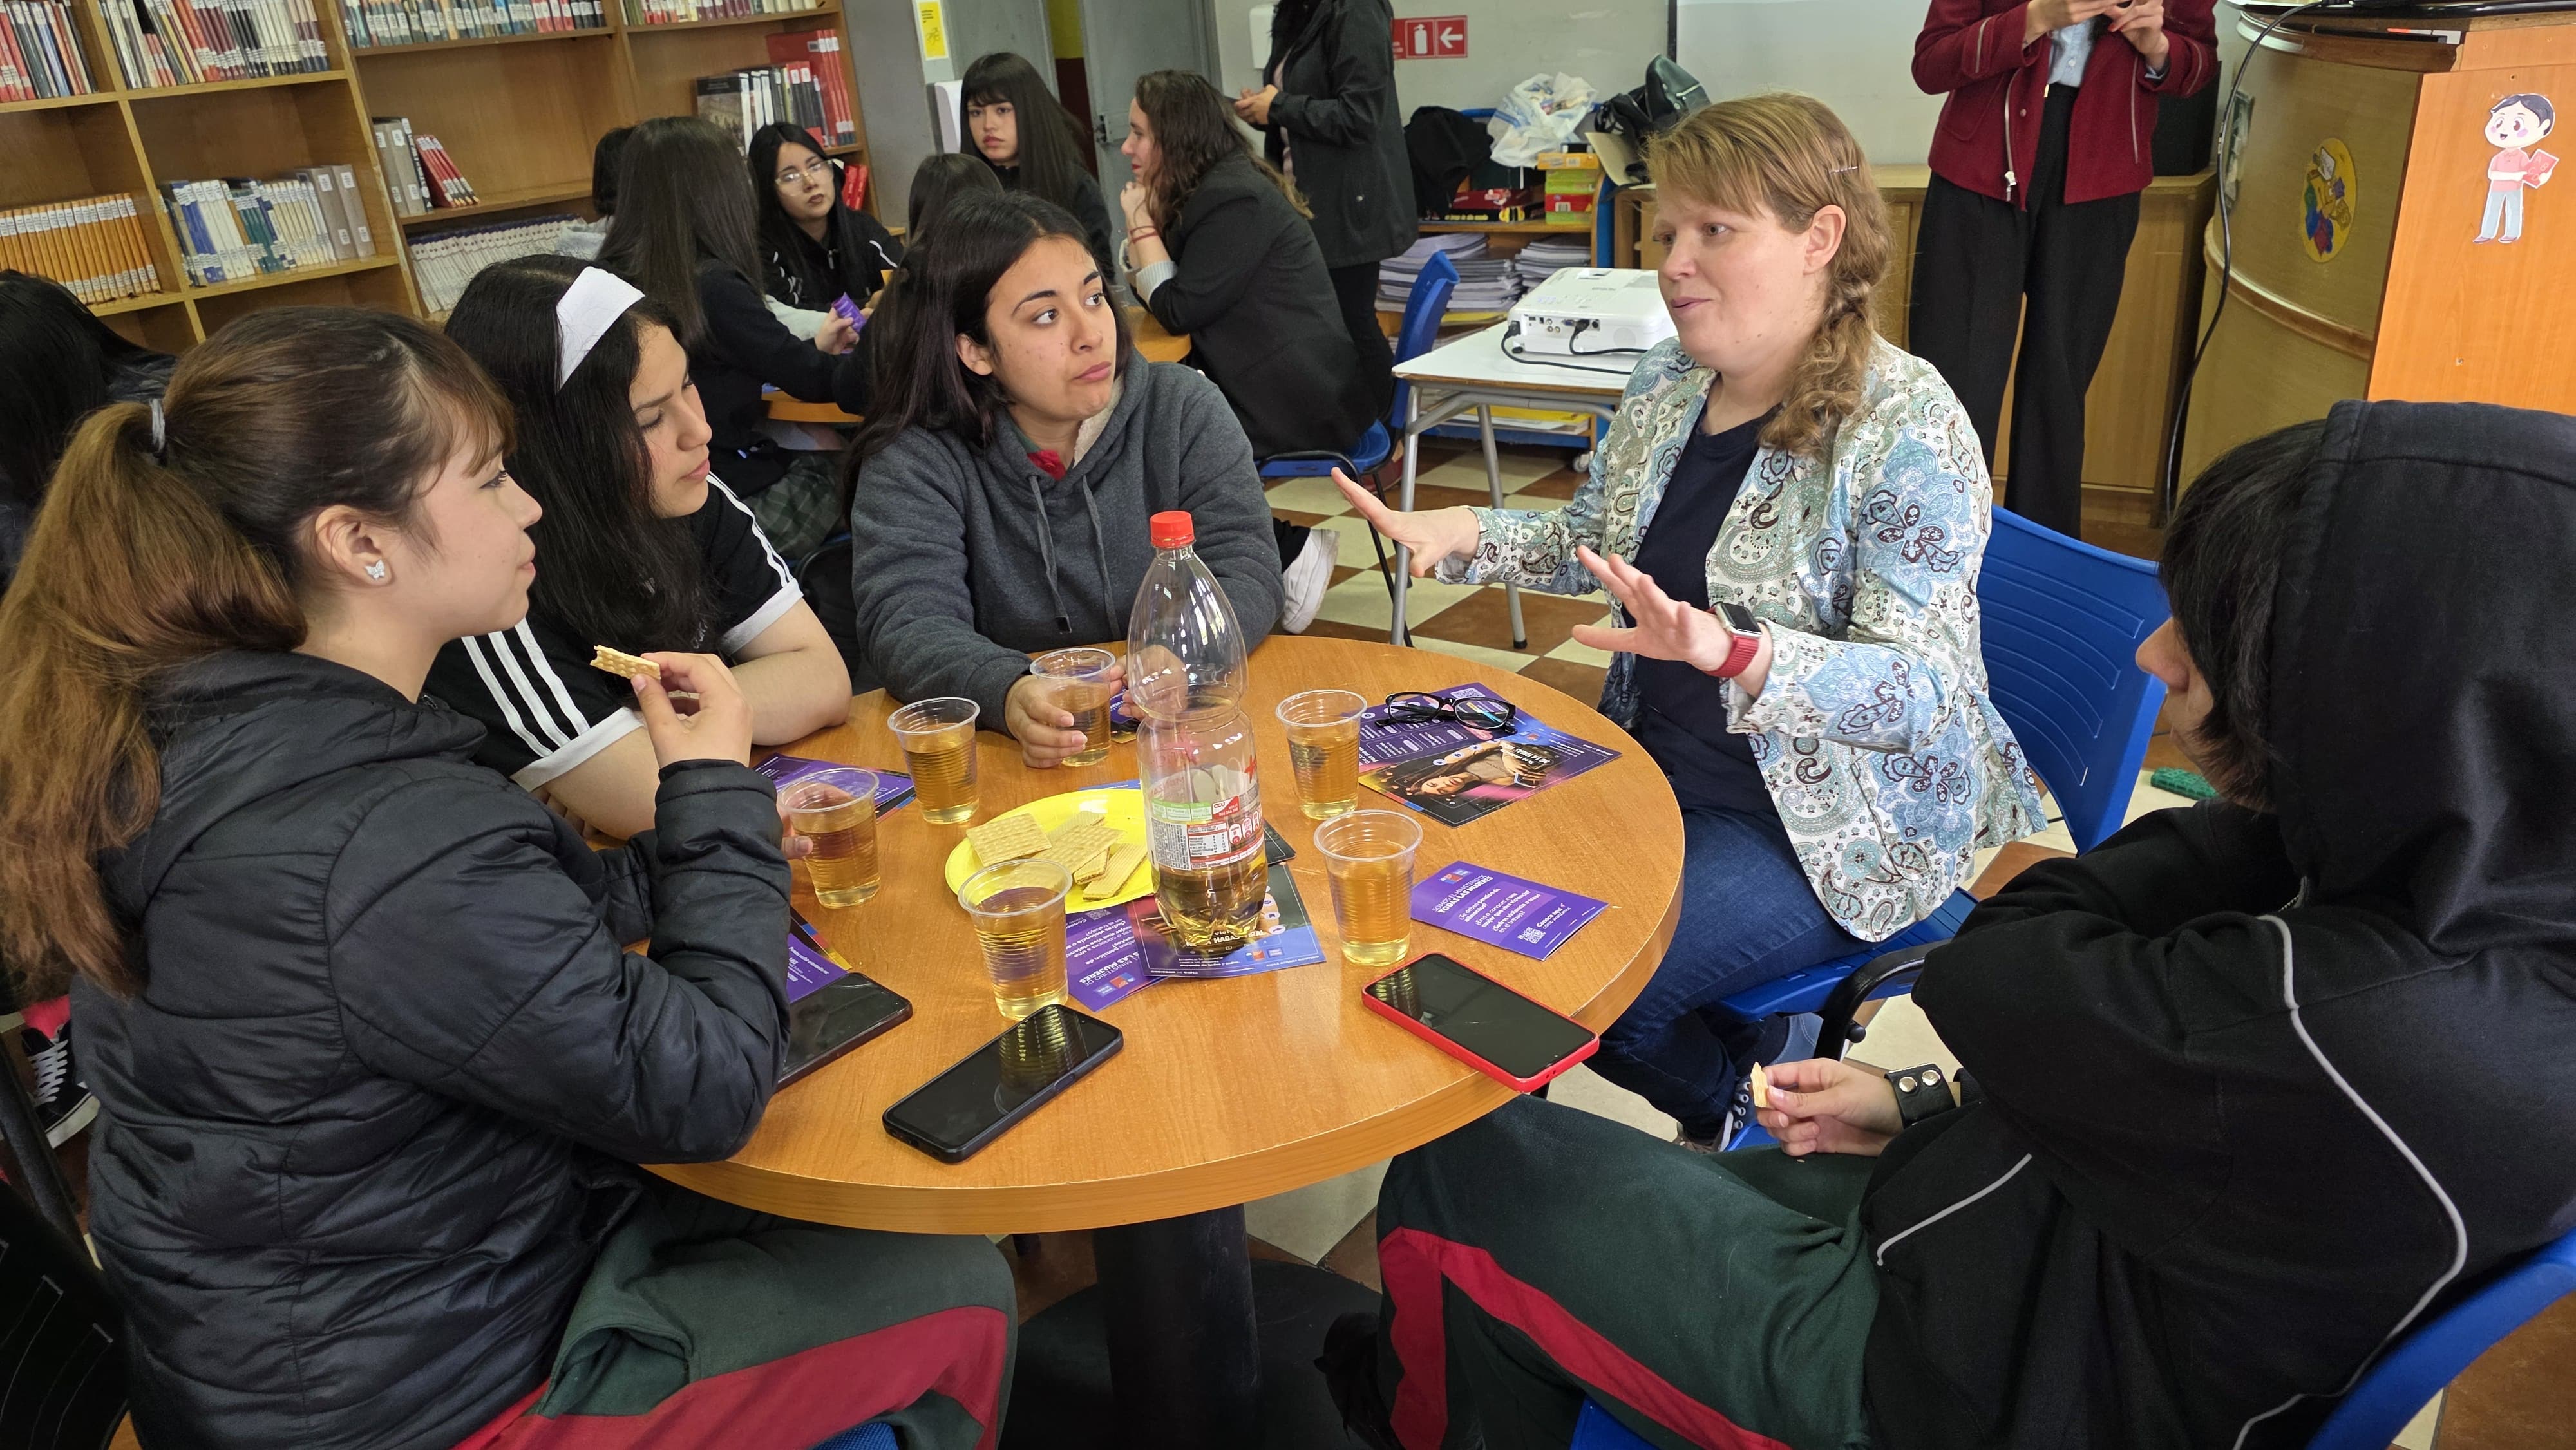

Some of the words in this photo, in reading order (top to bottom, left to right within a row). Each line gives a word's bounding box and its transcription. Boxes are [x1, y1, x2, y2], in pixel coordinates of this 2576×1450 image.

[1432, 898, 1454, 912] SOMOS
[1454, 878, 1480, 894] MINISTERIO
[1437, 898, 1460, 913] TODAS
[1466, 876, 1493, 891] MUJERES
[1465, 903, 1479, 913] deben
[1489, 900, 1507, 913] conoces
[1506, 903, 1526, 918] violencia
[1481, 916, 1495, 927] mujer
[1508, 911, 1525, 924] trabajo?
[1537, 914, 1554, 927] Conoce
[1076, 930, 1105, 945] violencia
[1092, 936, 1117, 948] conoces
[1094, 947, 1119, 961] pensión
[1117, 955, 1134, 964] LAS
[1079, 962, 1118, 984] MUJERES
[1095, 961, 1132, 981] MINISTERIO
